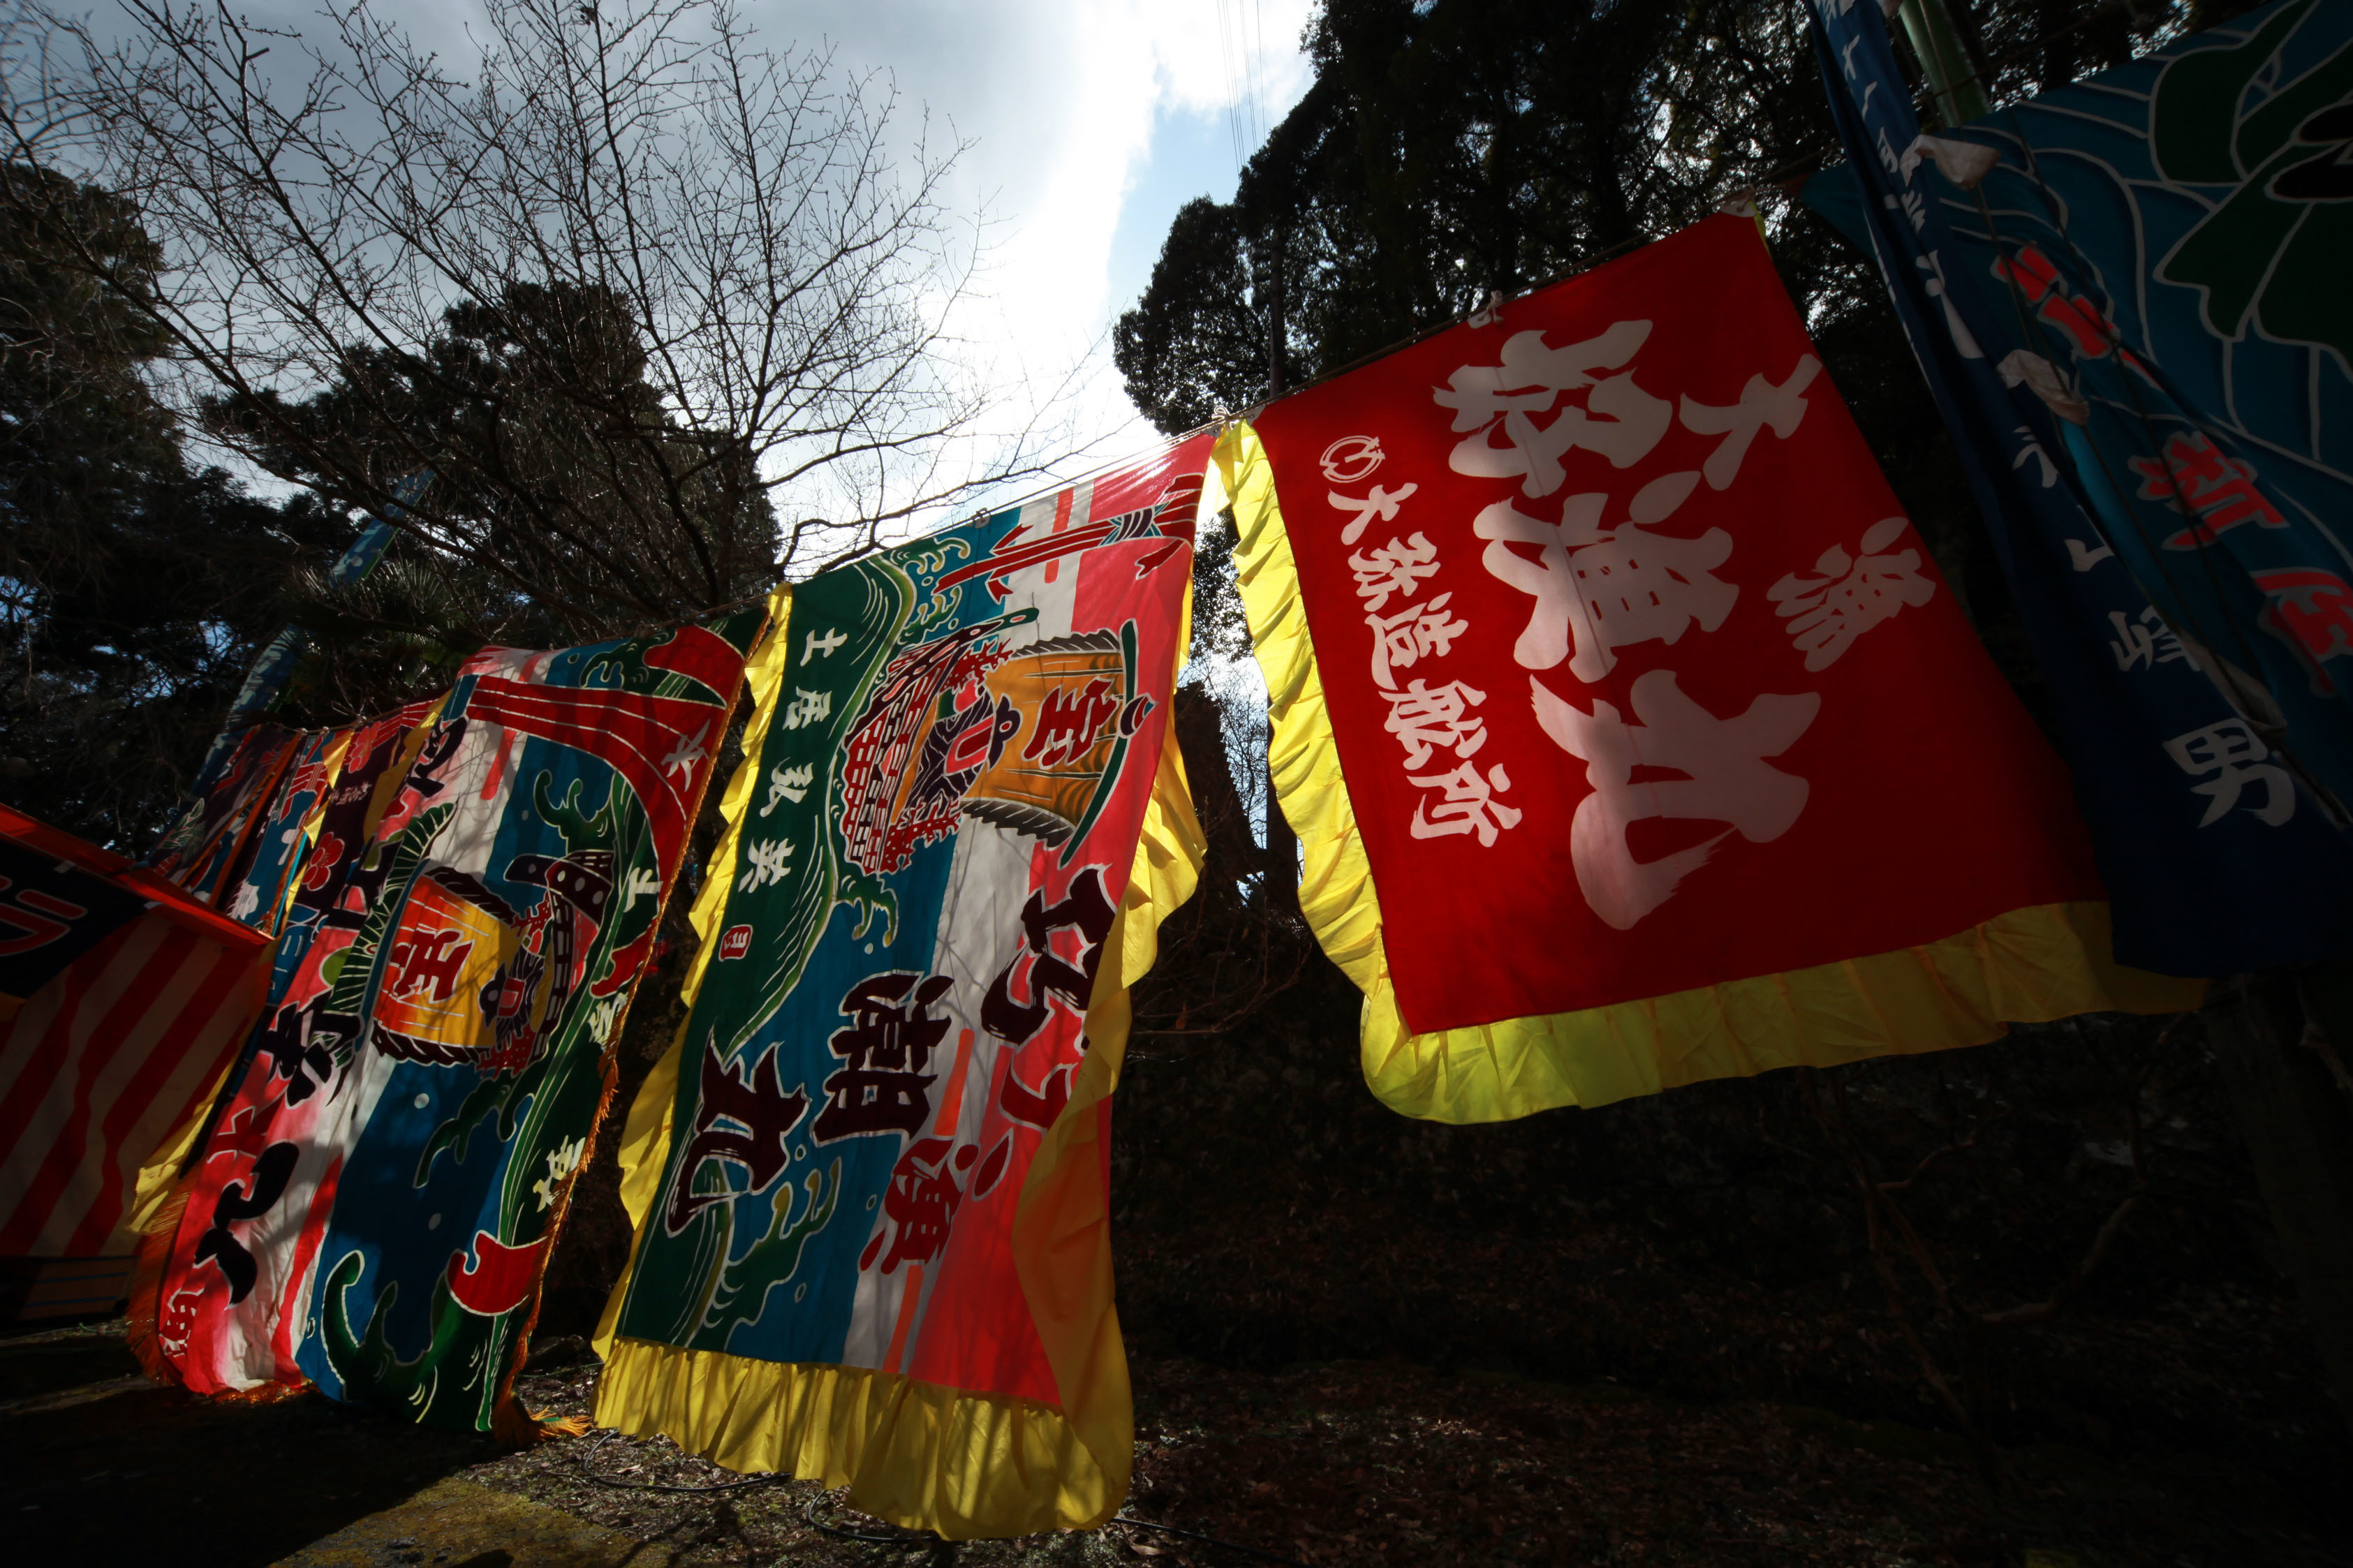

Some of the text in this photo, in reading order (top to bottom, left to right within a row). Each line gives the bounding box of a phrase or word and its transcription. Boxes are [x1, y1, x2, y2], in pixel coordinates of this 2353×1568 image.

[1430, 318, 1822, 931] 好漁丸
[1678, 351, 1938, 674] 大漁
[1022, 679, 1119, 768] 宝
